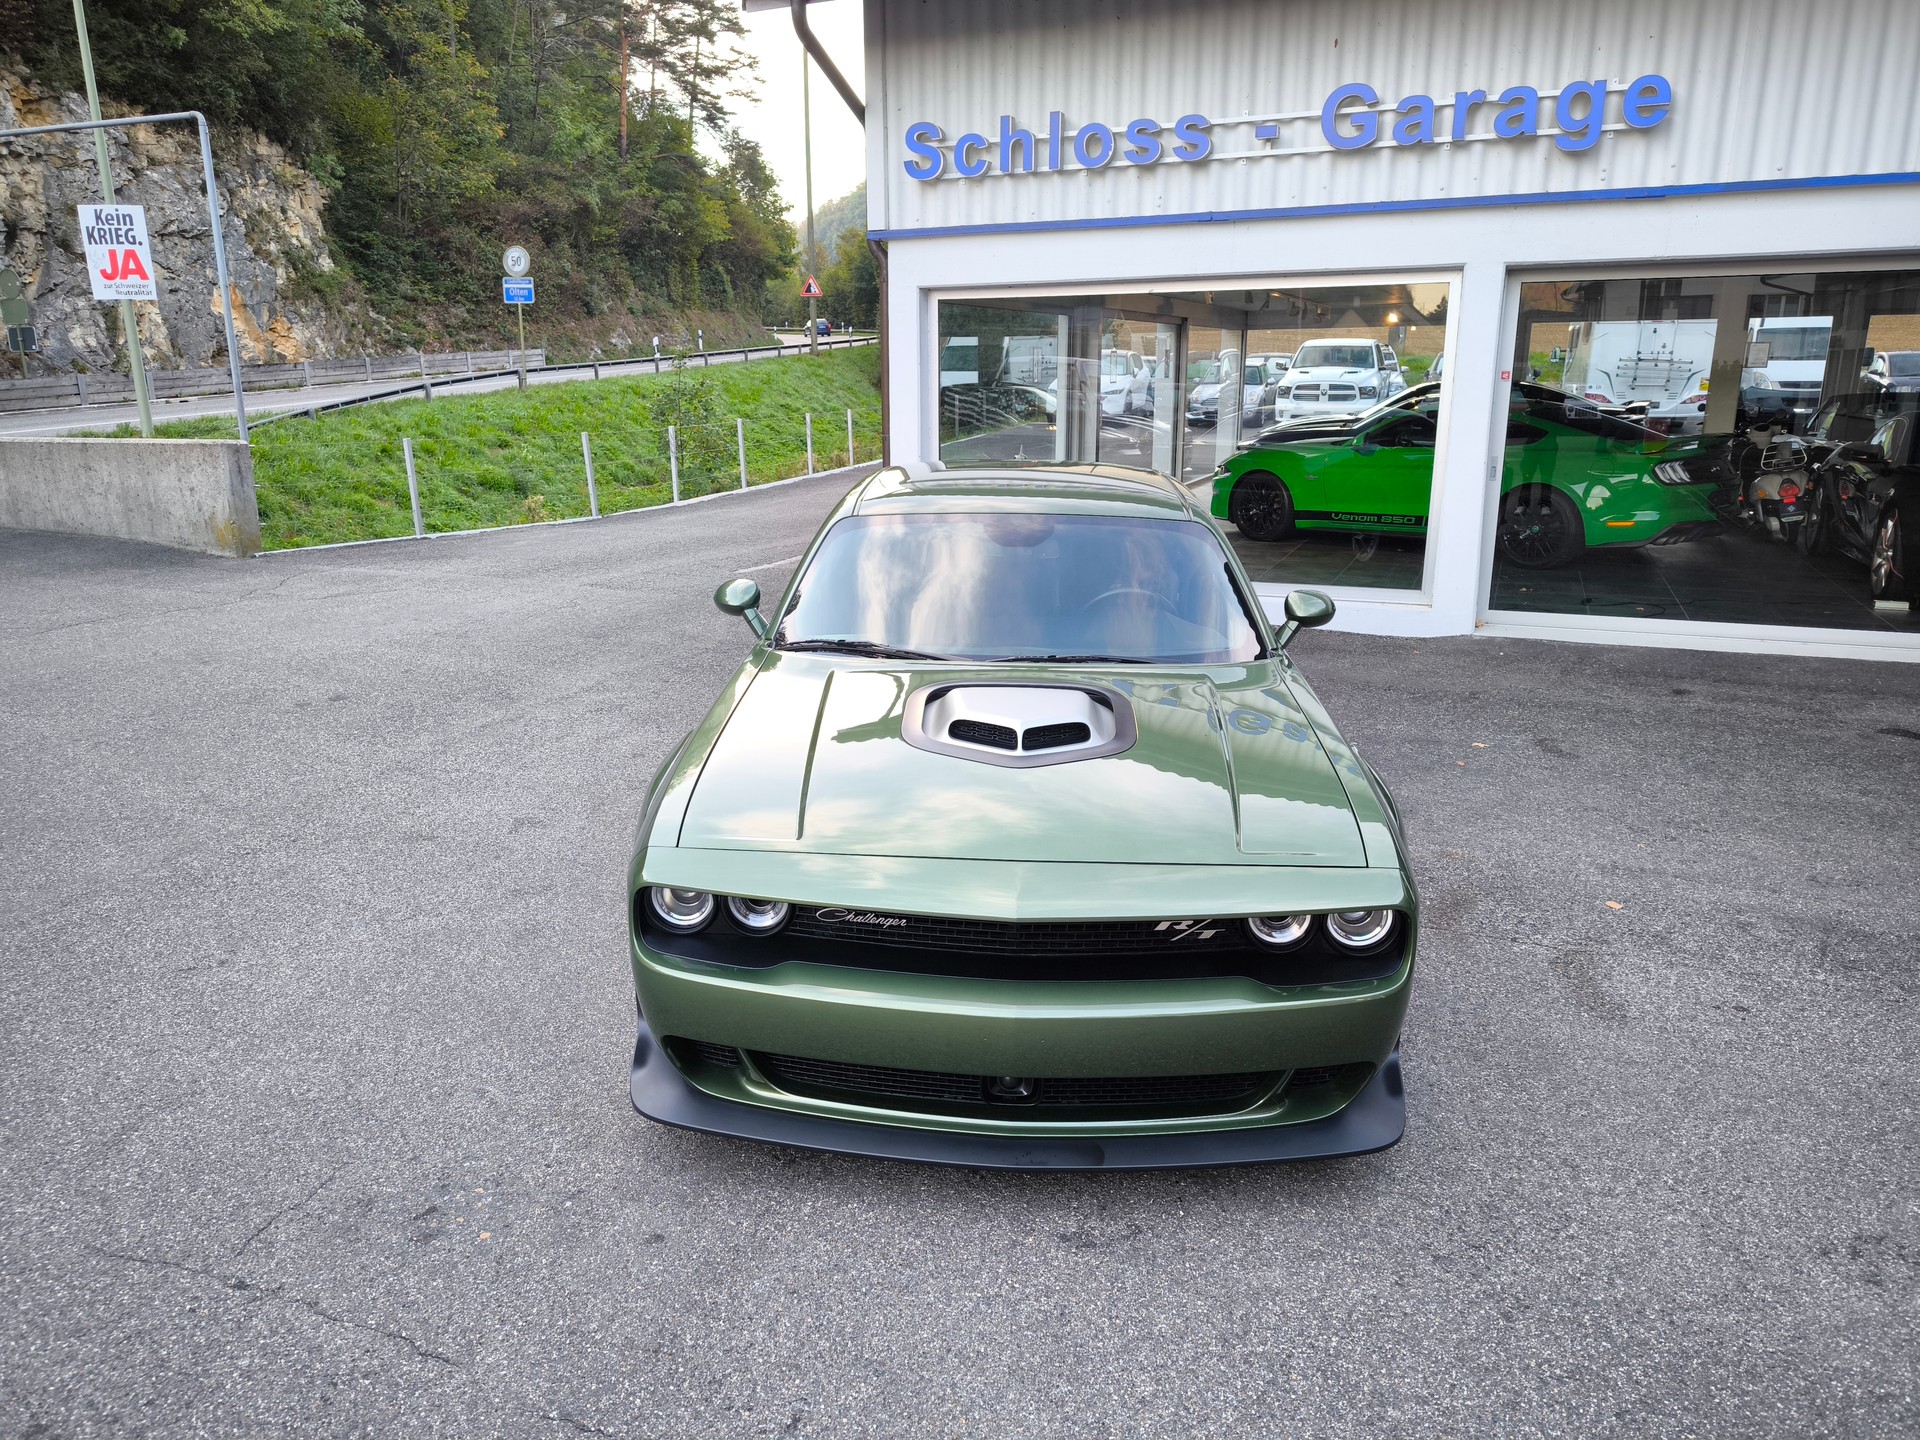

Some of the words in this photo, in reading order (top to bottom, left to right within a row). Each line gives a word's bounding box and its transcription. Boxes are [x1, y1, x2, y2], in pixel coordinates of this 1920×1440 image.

[904, 110, 1213, 181] Schloss
[1255, 124, 1280, 140] -
[1320, 74, 1672, 151] Garage
[94, 208, 134, 226] Kein
[86, 226, 143, 246] KRIEG.
[99, 249, 150, 281] JA
[511, 255, 522, 267] 50
[509, 287, 529, 296] Olten
[1331, 512, 1378, 522] Venom
[1380, 515, 1416, 524] 850
[815, 907, 907, 929] Challenger
[1153, 918, 1226, 941] R/T
